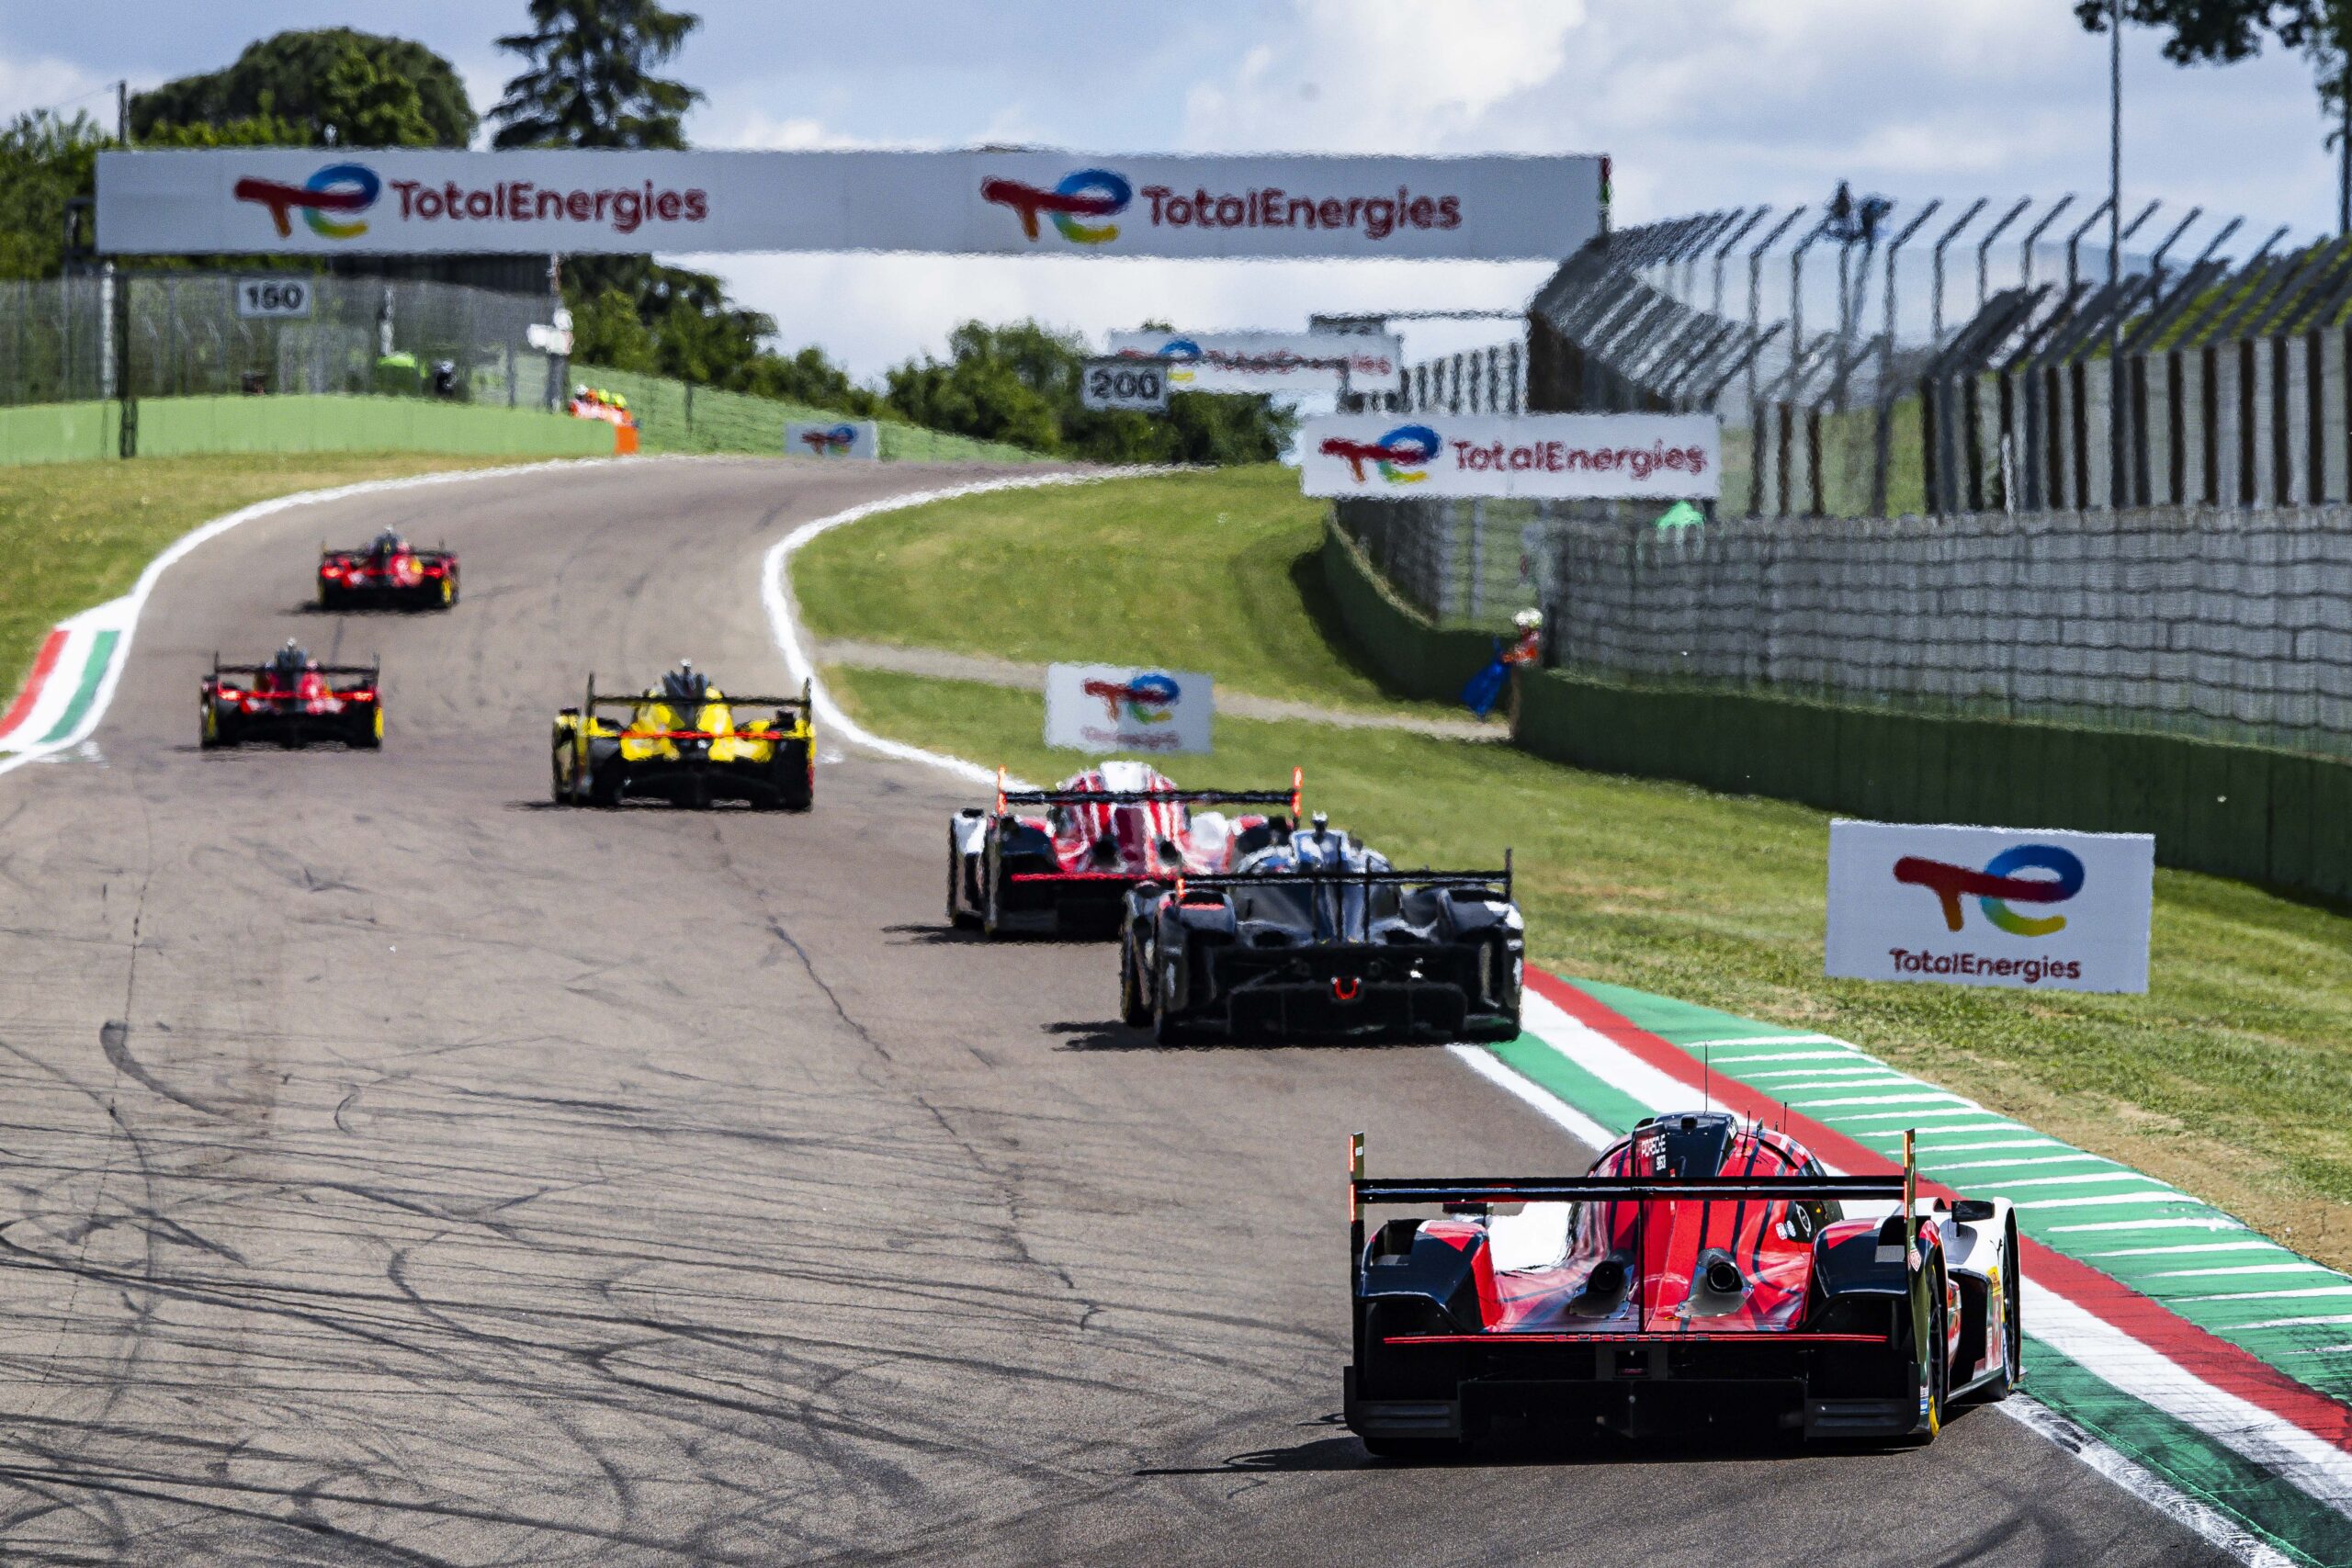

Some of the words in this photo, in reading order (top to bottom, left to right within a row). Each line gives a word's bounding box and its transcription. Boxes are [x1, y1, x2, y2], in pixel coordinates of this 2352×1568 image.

[389, 179, 707, 233] TotalEnergies
[1140, 186, 1463, 241] TotalEnergies
[245, 281, 305, 310] 150
[1090, 369, 1160, 400] 200
[1449, 436, 1709, 481] TotalEnergies
[1889, 947, 2082, 984] TotalEnergies
